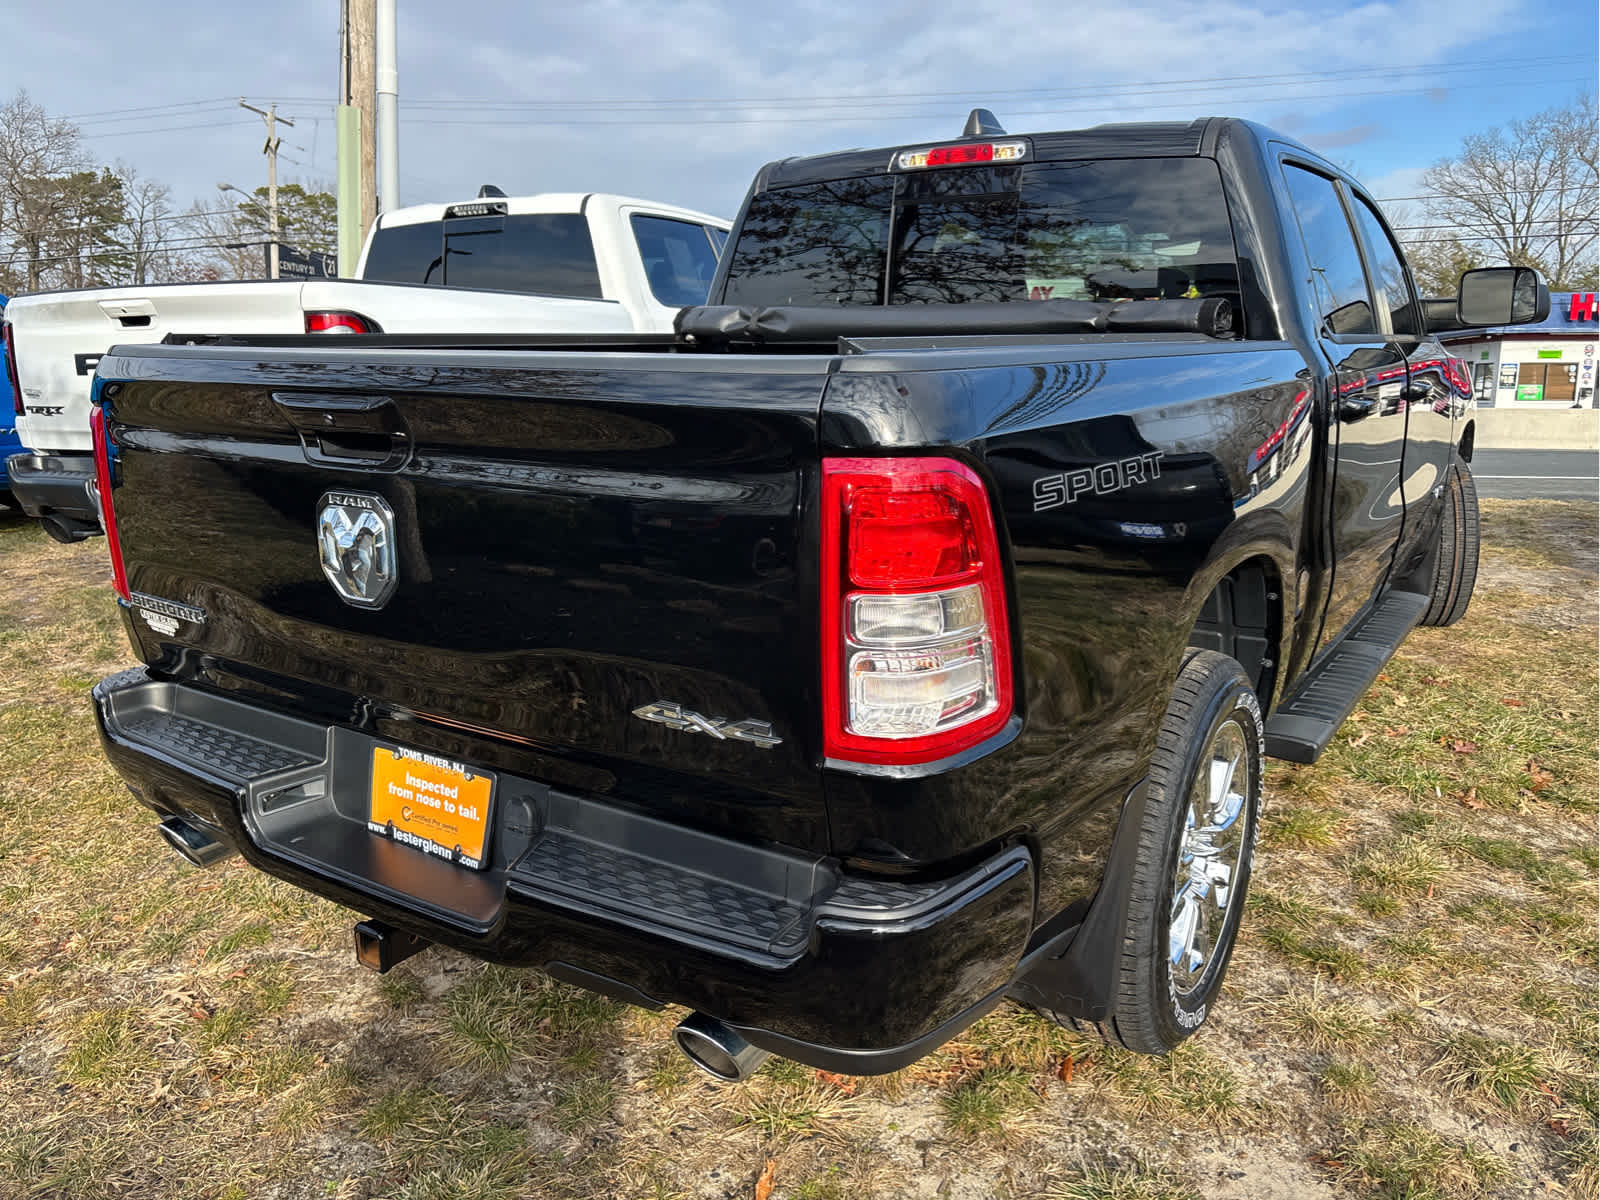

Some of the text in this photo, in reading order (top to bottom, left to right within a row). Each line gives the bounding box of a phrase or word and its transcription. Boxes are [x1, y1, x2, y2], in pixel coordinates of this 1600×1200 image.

[1032, 450, 1165, 512] SPORT
[327, 493, 374, 510] RAM
[398, 747, 422, 762] TOMS
[423, 753, 452, 770] RIVER,
[405, 772, 458, 799] Inspected
[388, 782, 480, 821] from nose to tail.
[393, 826, 452, 860] lesterglenn
